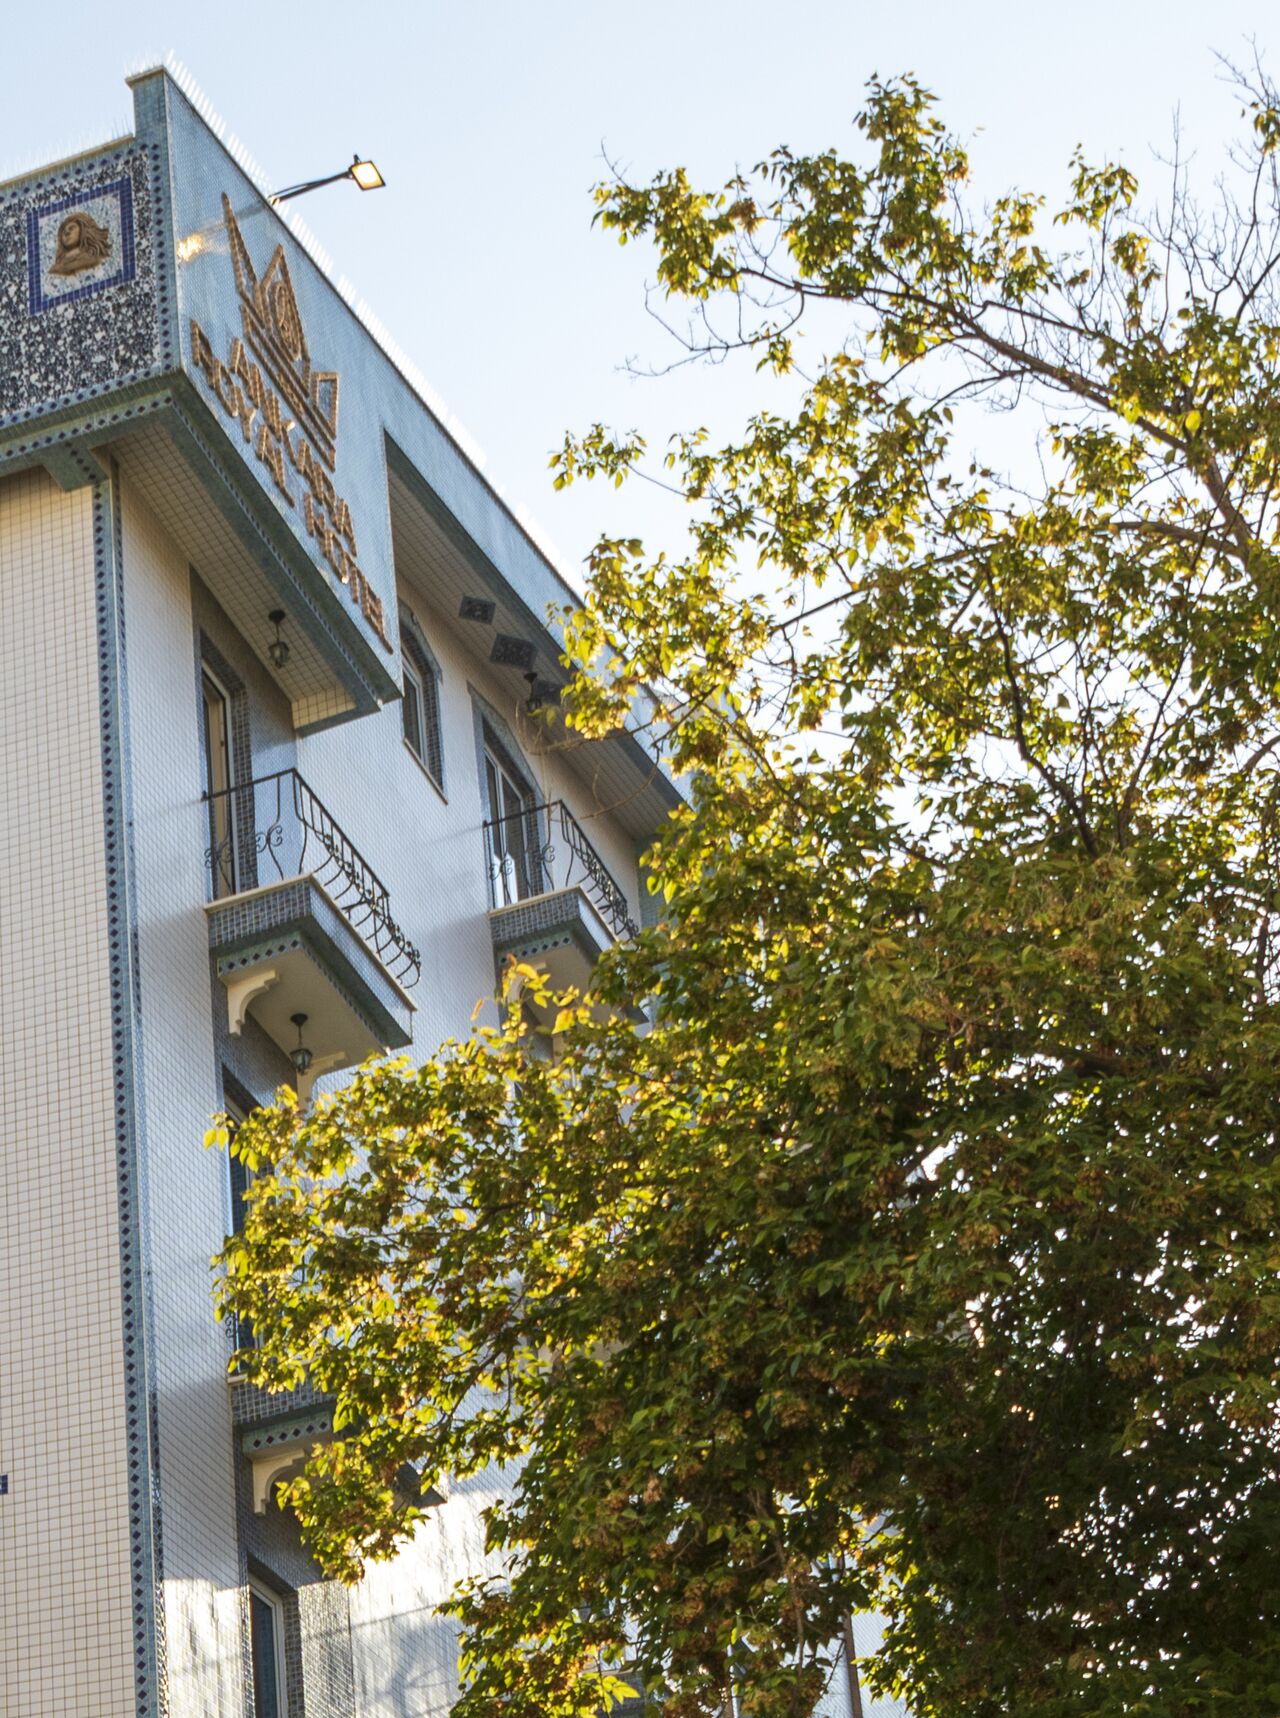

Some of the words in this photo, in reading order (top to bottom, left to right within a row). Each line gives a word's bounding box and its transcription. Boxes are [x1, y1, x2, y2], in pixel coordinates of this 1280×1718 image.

[190, 319, 295, 508] ROYAL
[303, 491, 394, 655] HOTEL
[229, 337, 357, 557] ANKARA
